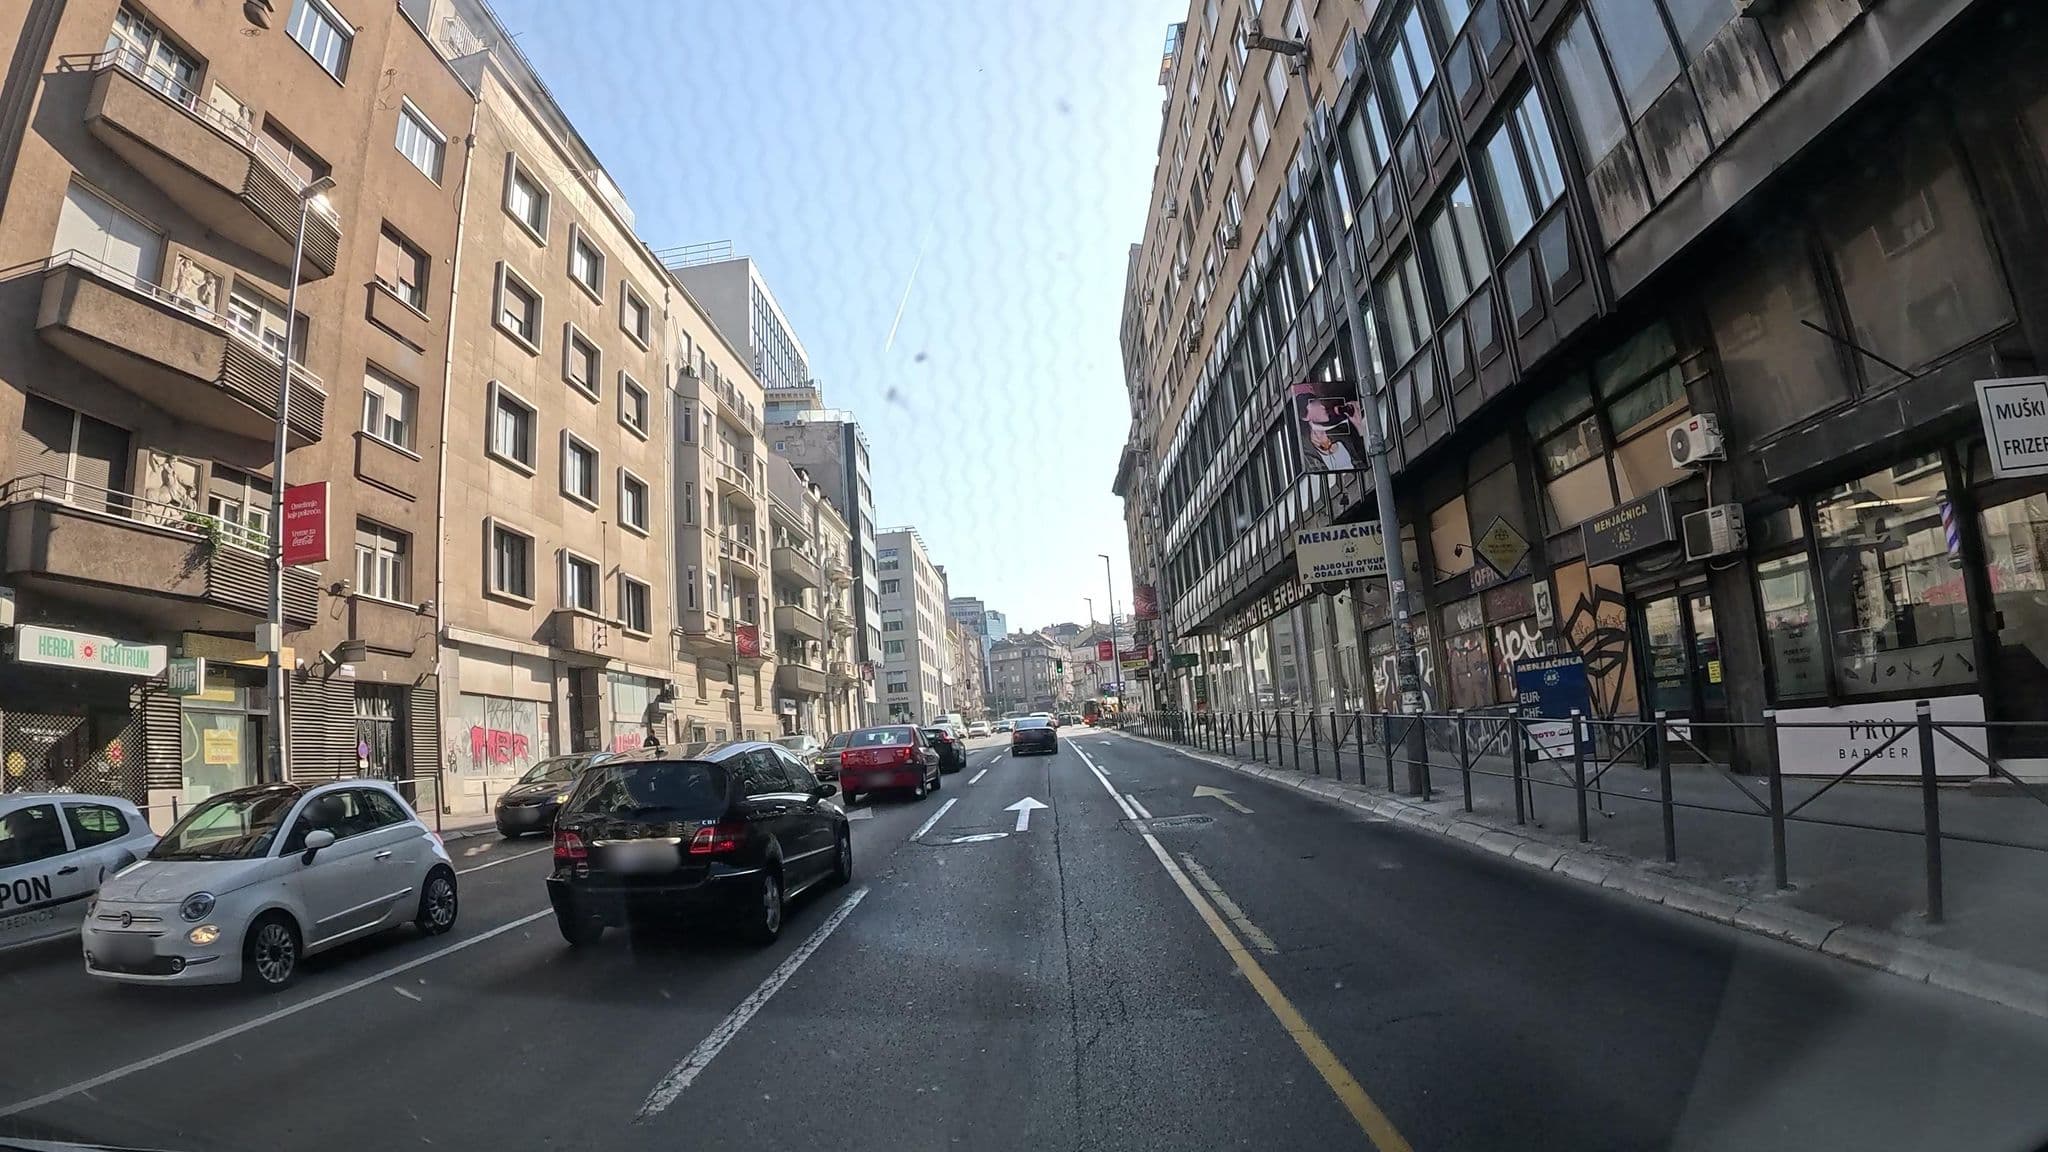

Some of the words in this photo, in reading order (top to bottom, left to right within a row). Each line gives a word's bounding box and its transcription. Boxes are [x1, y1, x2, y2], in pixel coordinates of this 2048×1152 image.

[1996, 398, 2046, 420] MUŠKI
[1593, 503, 1649, 533] MENJAČNICA
[1618, 529, 1631, 544] AS
[1303, 566, 1343, 581] PODAJA
[1345, 562, 1365, 575] SVIH
[1313, 560, 1353, 573] NAJBOLJI
[1356, 556, 1384, 567] OTKUP
[1246, 594, 1274, 628] HOTEL
[1273, 578, 1313, 612] SRBIJA
[38, 635, 75, 660] HERBA
[100, 643, 150, 669] CENTRUM
[1517, 655, 1584, 673] MENJAČNICA
[168, 662, 197, 692] Bilje
[1848, 717, 1897, 740] PRO
